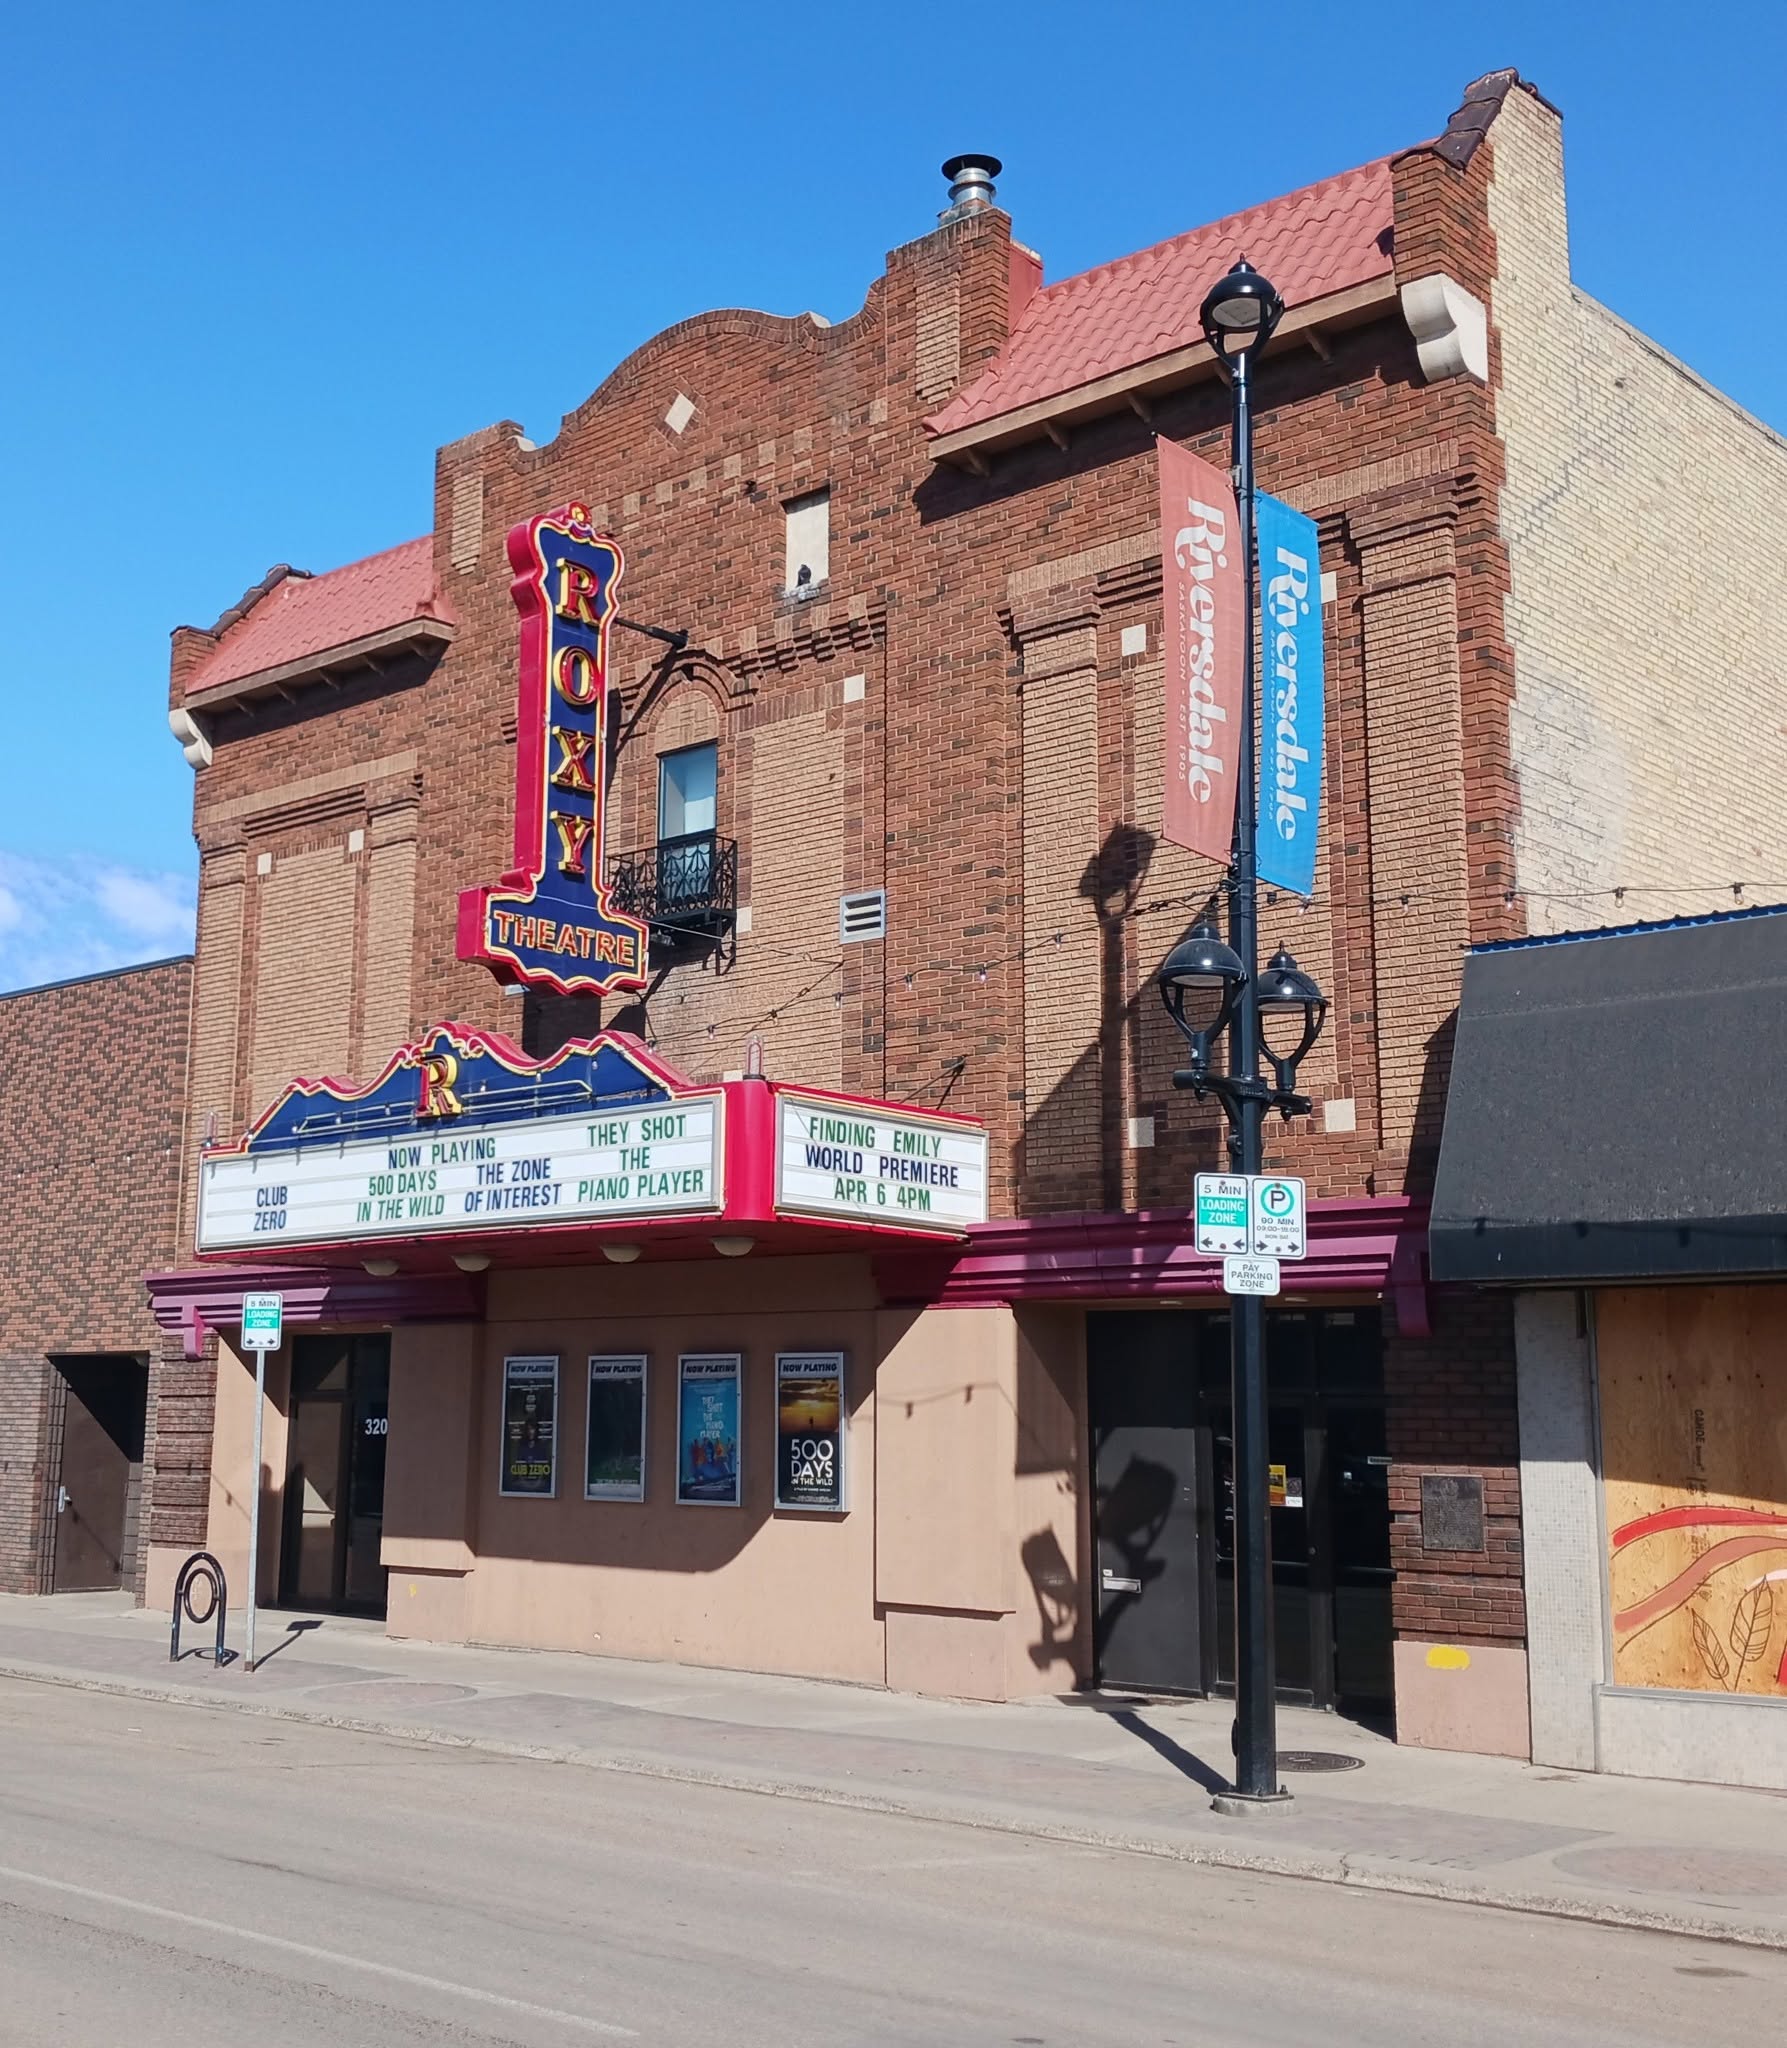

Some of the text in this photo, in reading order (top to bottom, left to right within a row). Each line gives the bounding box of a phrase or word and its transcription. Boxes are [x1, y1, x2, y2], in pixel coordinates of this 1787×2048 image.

[1178, 582, 1186, 681] SASKATOON
[1174, 496, 1227, 804] Riversdale
[1268, 546, 1311, 841] Riversdale
[549, 557, 600, 875] ROXY
[1178, 744, 1186, 782] 1905
[494, 910, 636, 967] THEATRE
[413, 1053, 462, 1117] R
[588, 1114, 687, 1148] THEY SHOT
[810, 1116, 942, 1158] FINDING EMILY
[388, 1137, 496, 1170] NOW PLAYING
[620, 1146, 651, 1171] THE
[476, 1157, 551, 1185] THE ZONE
[805, 1144, 959, 1188] WORLD PREMIERE
[368, 1169, 437, 1196] 500 DAYS
[578, 1169, 704, 1203] PIANO PLAYER
[834, 1177, 931, 1211] APR 6 4PM
[1204, 1184, 1242, 1196] 5 MIN
[256, 1185, 288, 1208] CLUB
[356, 1194, 445, 1222] IN THE WILD
[464, 1183, 562, 1213] OF INTEREST
[1200, 1199, 1245, 1211] LOADING
[1270, 1190, 1286, 1209] P
[253, 1210, 287, 1232] ZERO
[1208, 1212, 1237, 1223] ZONE
[1277, 1218, 1295, 1226] MIN
[1231, 1271, 1273, 1280] PARKING
[1242, 1263, 1260, 1272] PAY
[1239, 1280, 1265, 1288] ZONE
[510, 1365, 526, 1373] NOW
[595, 1365, 612, 1373] NOW
[686, 1365, 704, 1373] NOW
[782, 1362, 837, 1372] NOW PLAYING
[364, 1418, 388, 1435] 320
[791, 1439, 834, 1461] 500
[511, 1464, 550, 1475] CLUB ZERO
[791, 1460, 833, 1479] DAYS
[800, 1477, 814, 1486] THE
[815, 1477, 833, 1486] WILD
